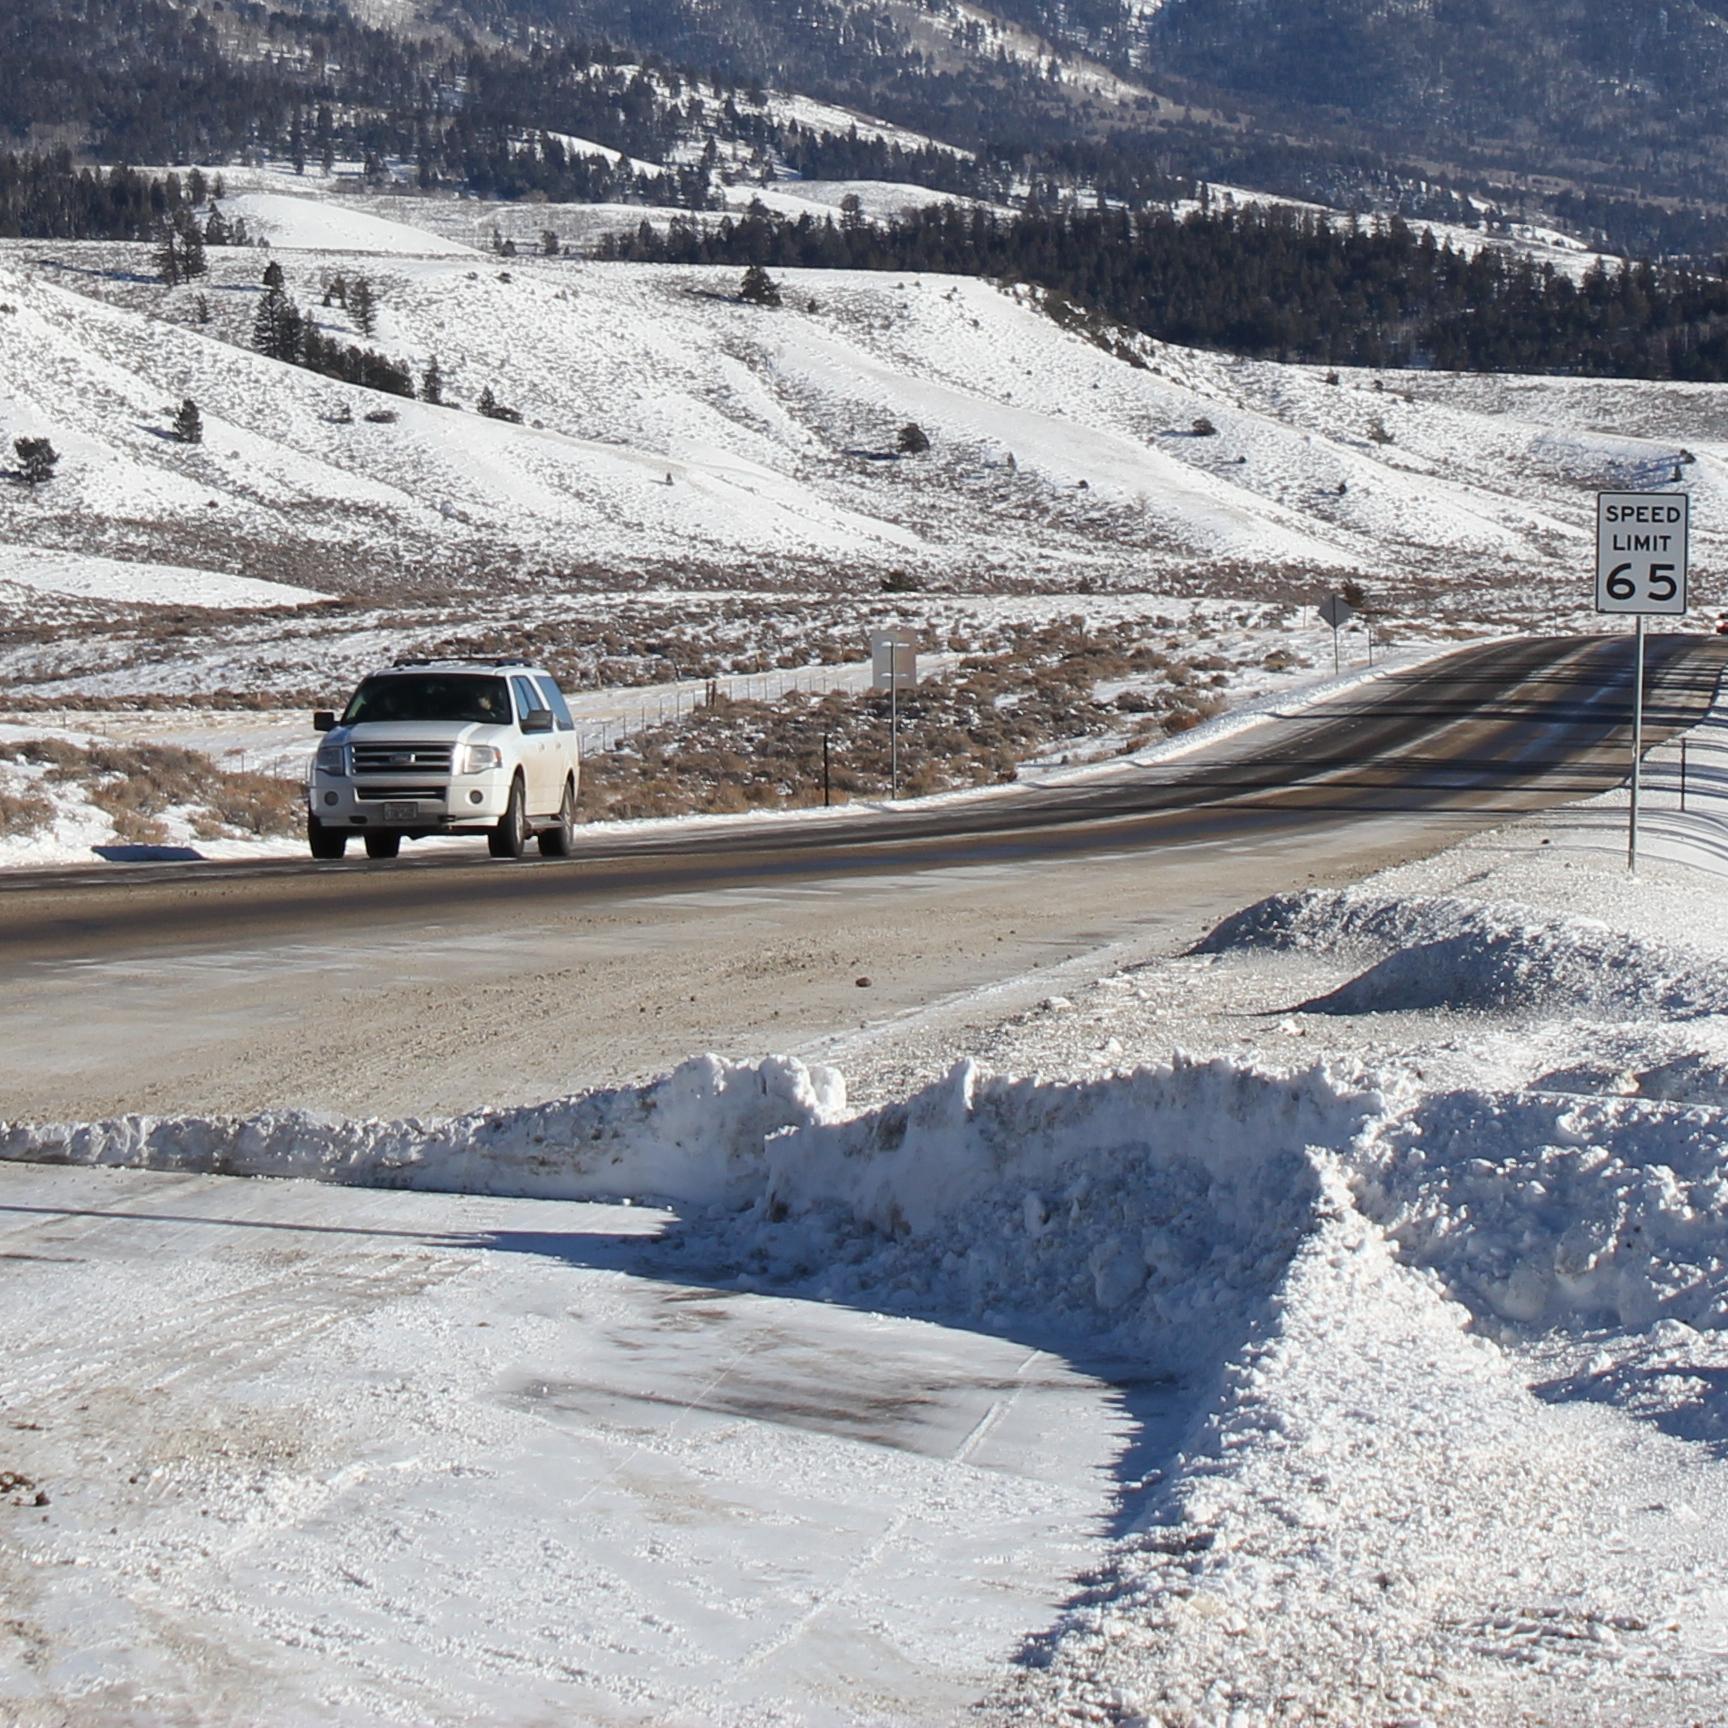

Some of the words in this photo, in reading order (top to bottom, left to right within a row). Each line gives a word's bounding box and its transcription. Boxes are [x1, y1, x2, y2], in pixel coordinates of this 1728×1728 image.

[1605, 505, 1681, 523] SPEED
[1613, 534, 1672, 551] LIMIT
[1606, 563, 1677, 602] 65
